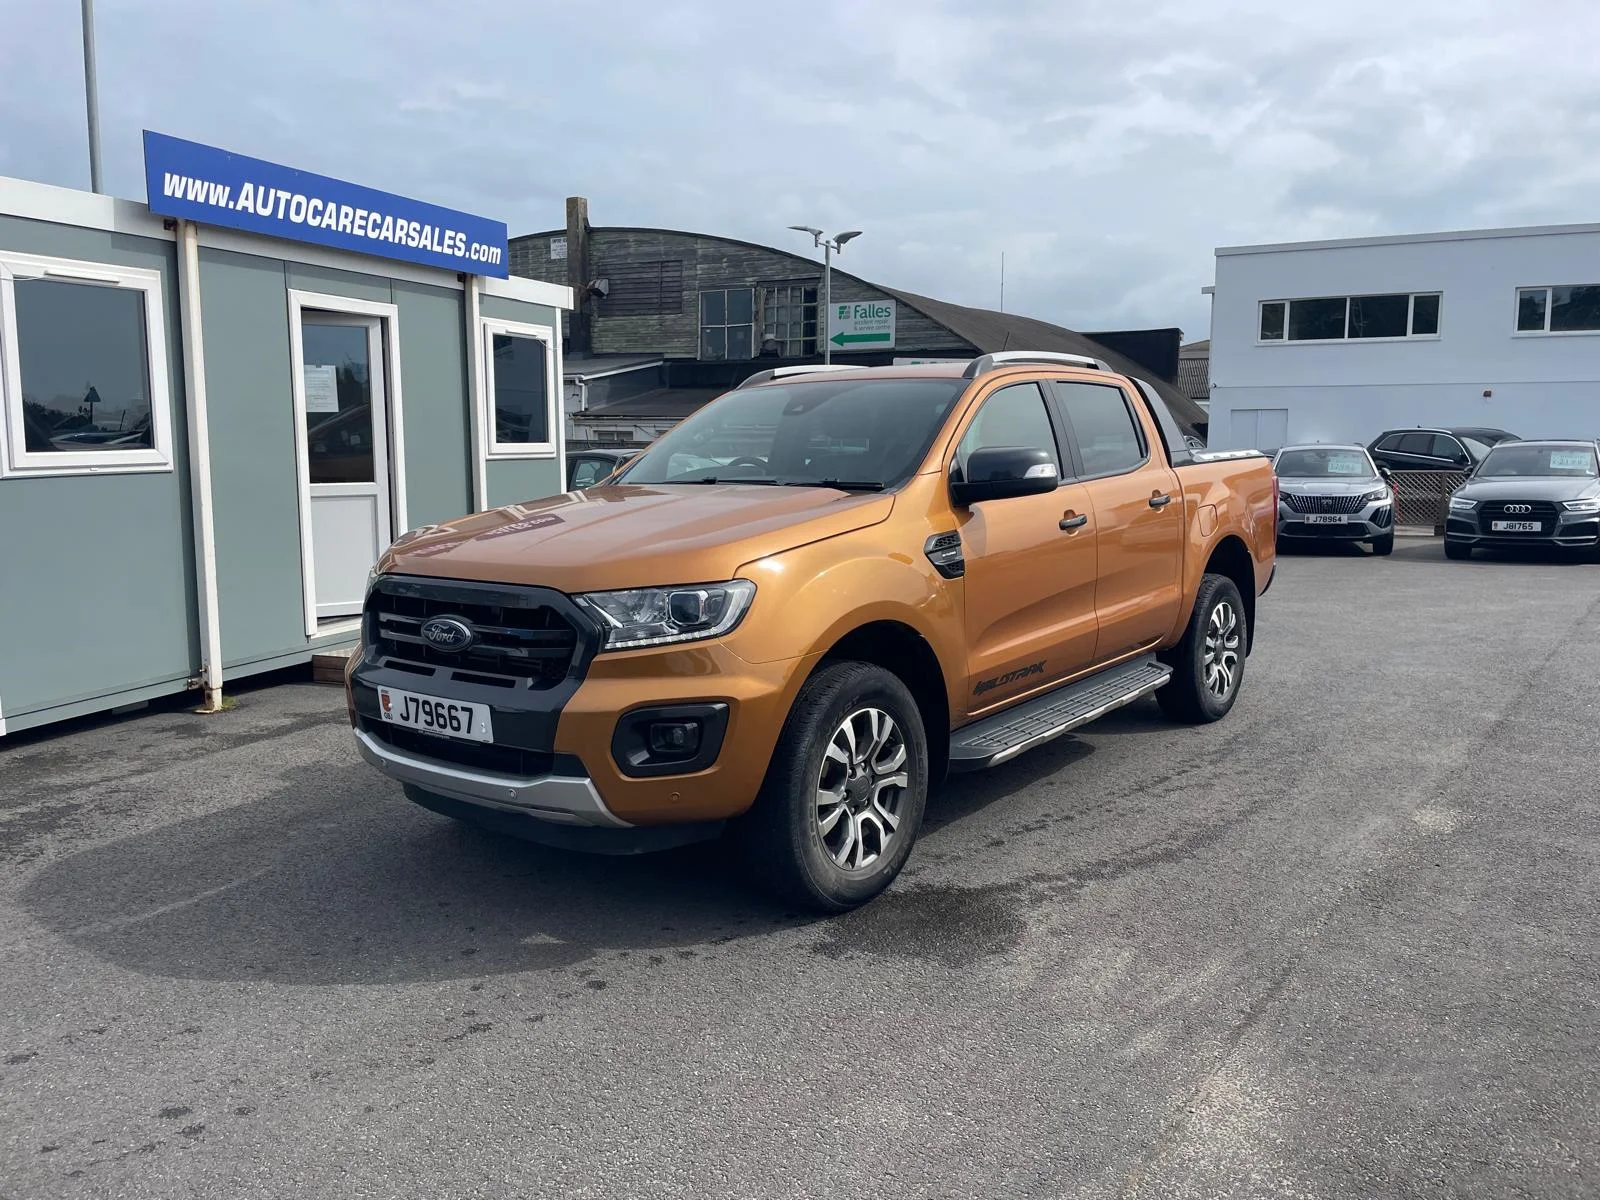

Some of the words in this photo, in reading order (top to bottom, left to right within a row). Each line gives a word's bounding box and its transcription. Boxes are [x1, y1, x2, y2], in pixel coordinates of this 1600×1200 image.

[163, 172, 502, 265] www.AUTOCARECARSALES.com
[854, 304, 891, 319] Falles
[1313, 515, 1342, 523] J78964
[428, 623, 457, 643] Ford
[400, 695, 474, 734] J79667
